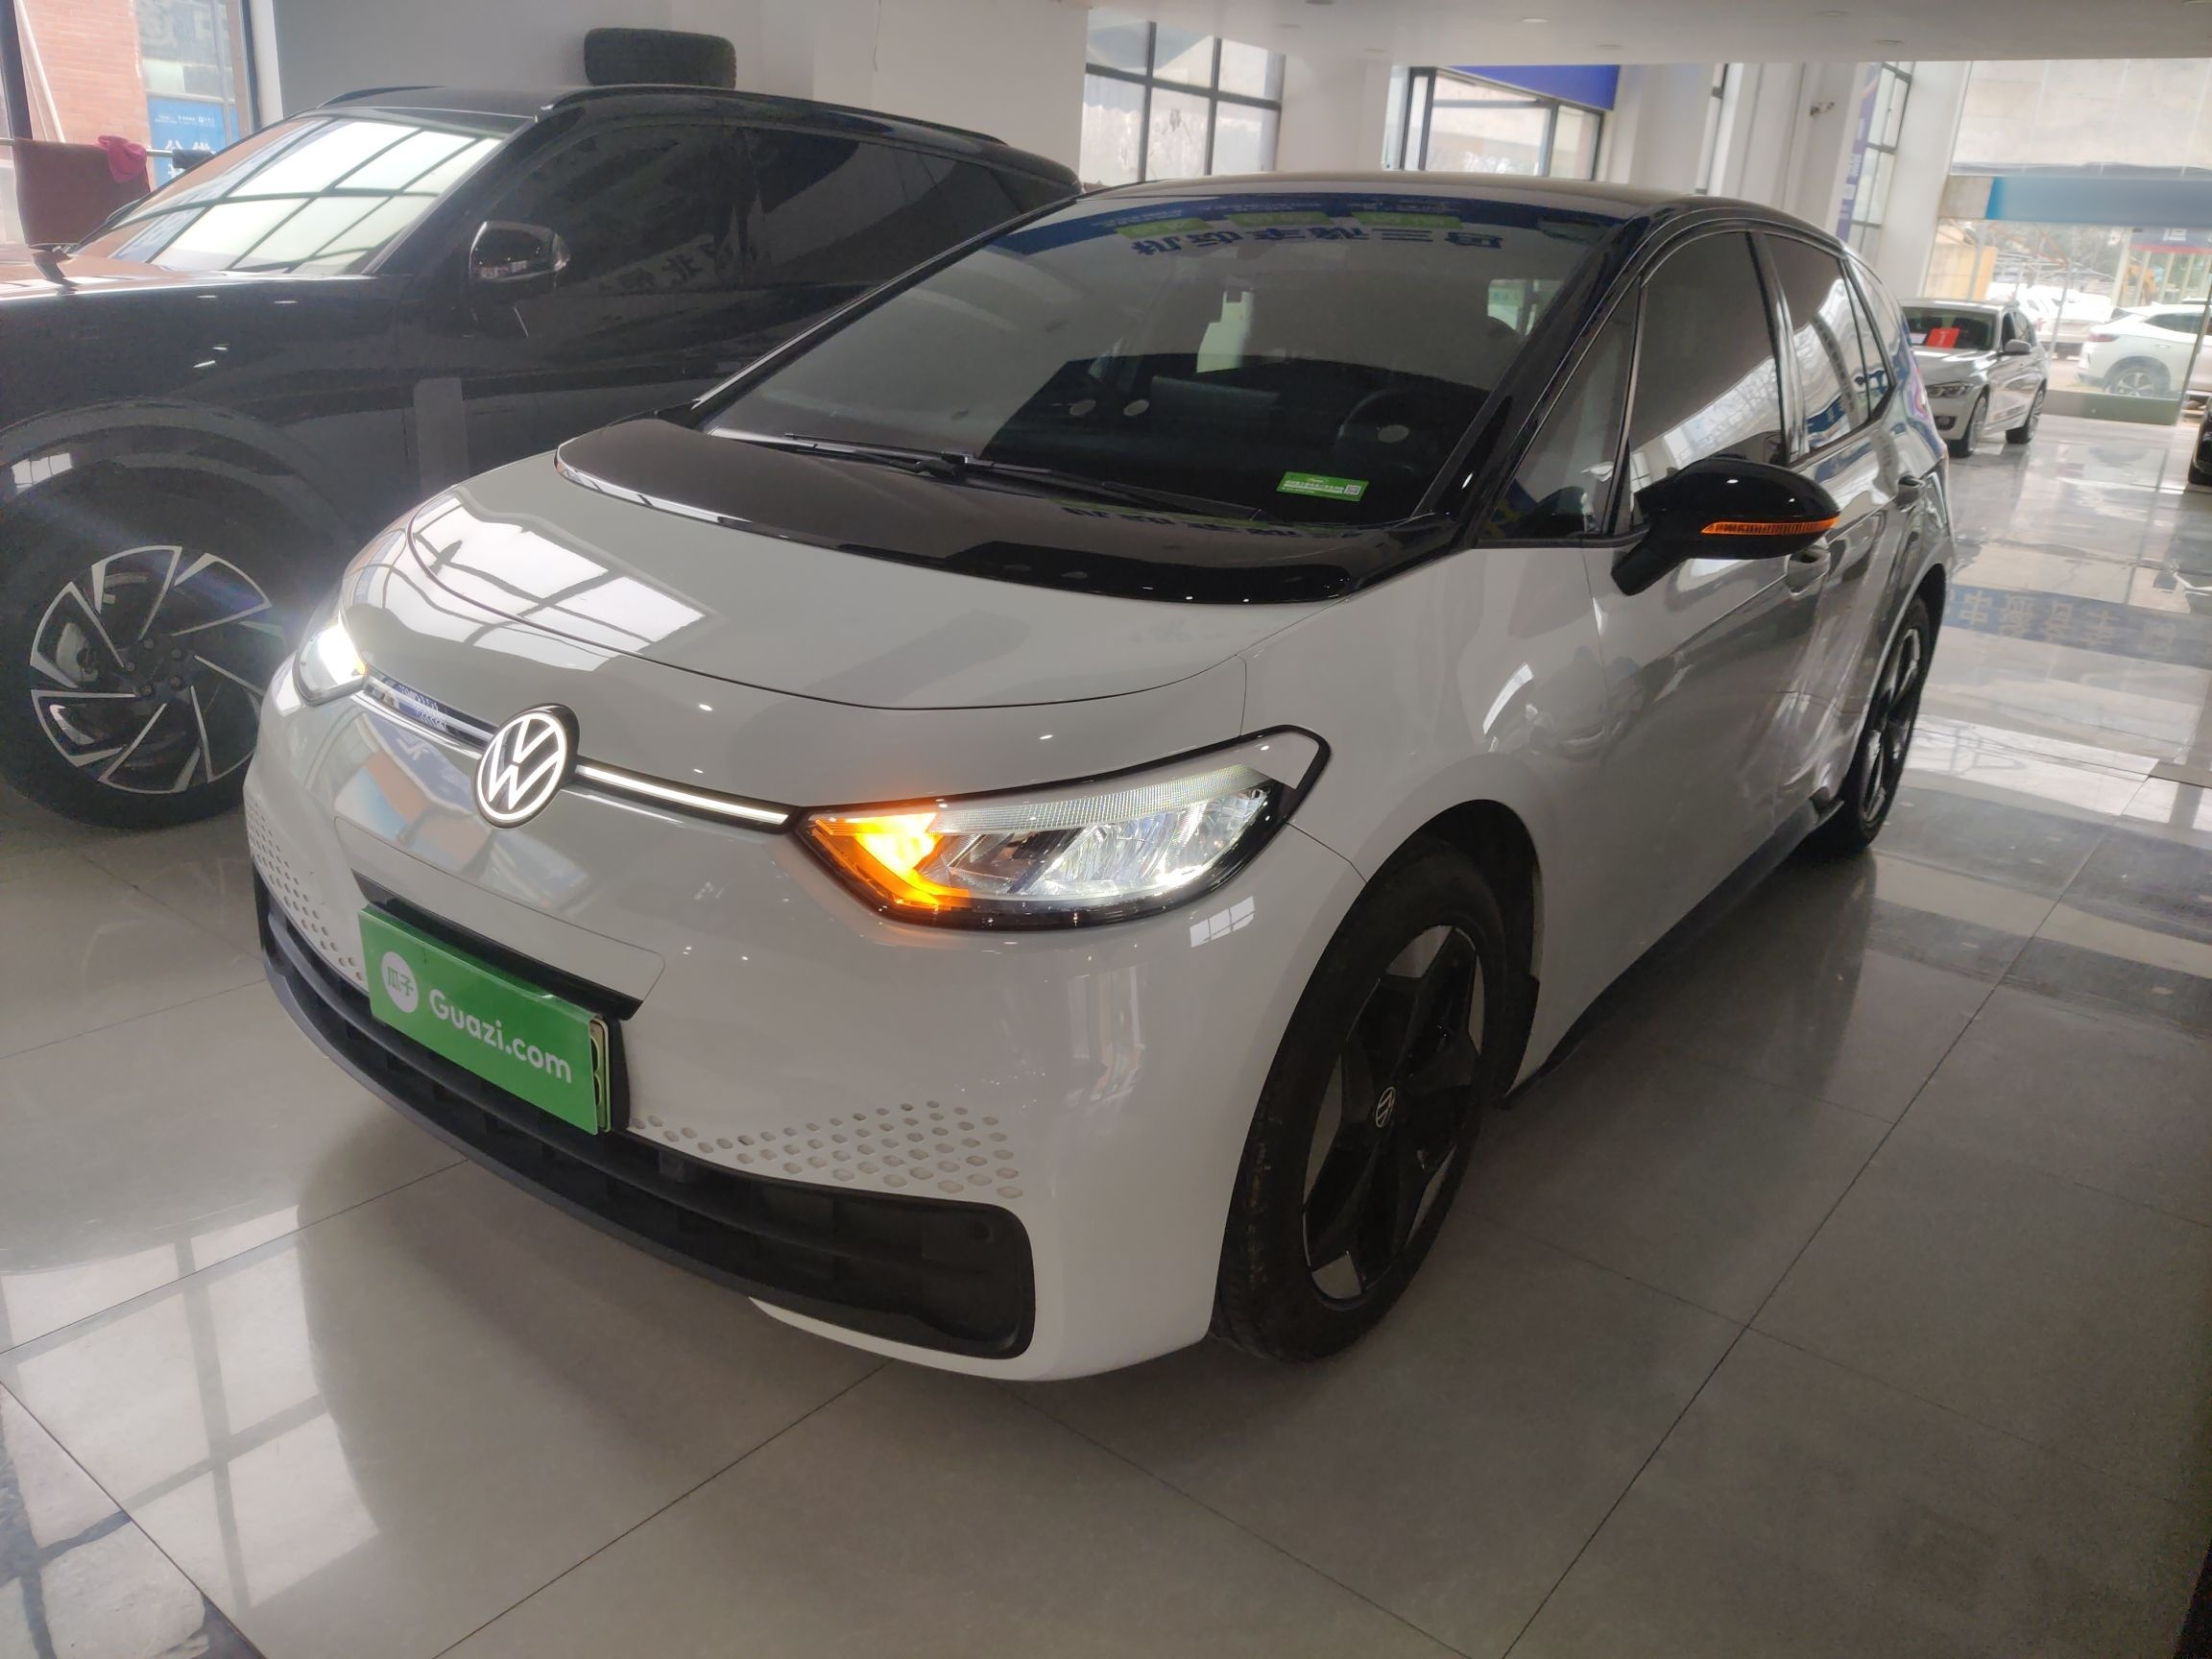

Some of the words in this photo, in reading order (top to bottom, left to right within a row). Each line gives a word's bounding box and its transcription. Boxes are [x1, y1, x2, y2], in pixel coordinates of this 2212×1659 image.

[483, 716, 564, 815] VW
[386, 965, 415, 998] 瓜子
[428, 988, 573, 1084] Guazi.com
